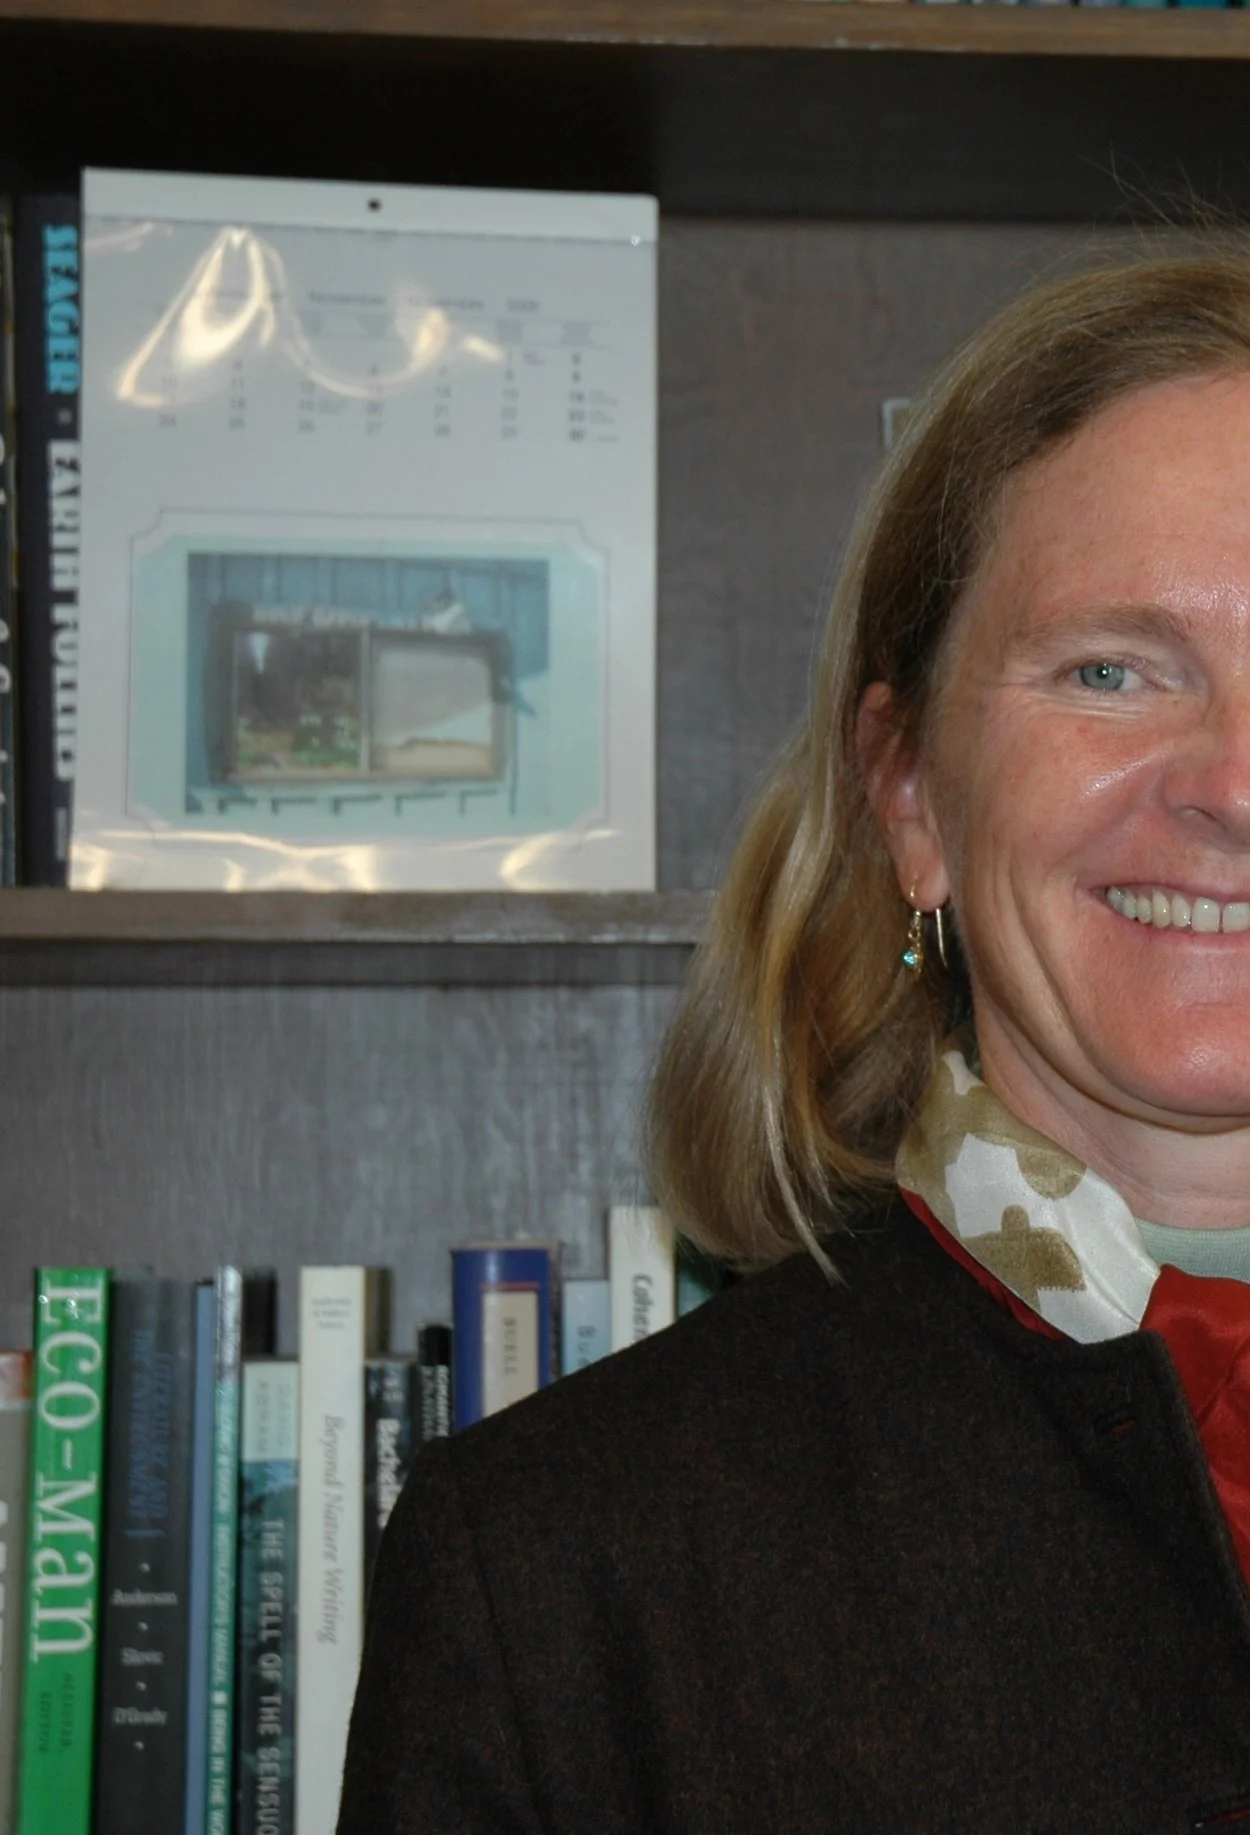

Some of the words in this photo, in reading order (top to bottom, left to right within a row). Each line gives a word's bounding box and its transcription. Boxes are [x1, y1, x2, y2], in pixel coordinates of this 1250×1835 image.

[45, 225, 81, 394] SEAGER
[50, 440, 82, 591] EARTH
[30, 1276, 104, 1664] ECO-Man
[319, 1414, 348, 1489] Beyond
[261, 1519, 286, 1561] THE
[320, 1492, 346, 1562] Nature
[108, 1588, 179, 1607] Anderson
[258, 1571, 284, 1641] SPELL
[315, 1568, 346, 1646] Writing
[258, 1652, 283, 1684] OF
[210, 1707, 228, 1753] BEING
[258, 1694, 283, 1737] THE
[209, 1777, 227, 1805] THE
[210, 1756, 227, 1774] IN
